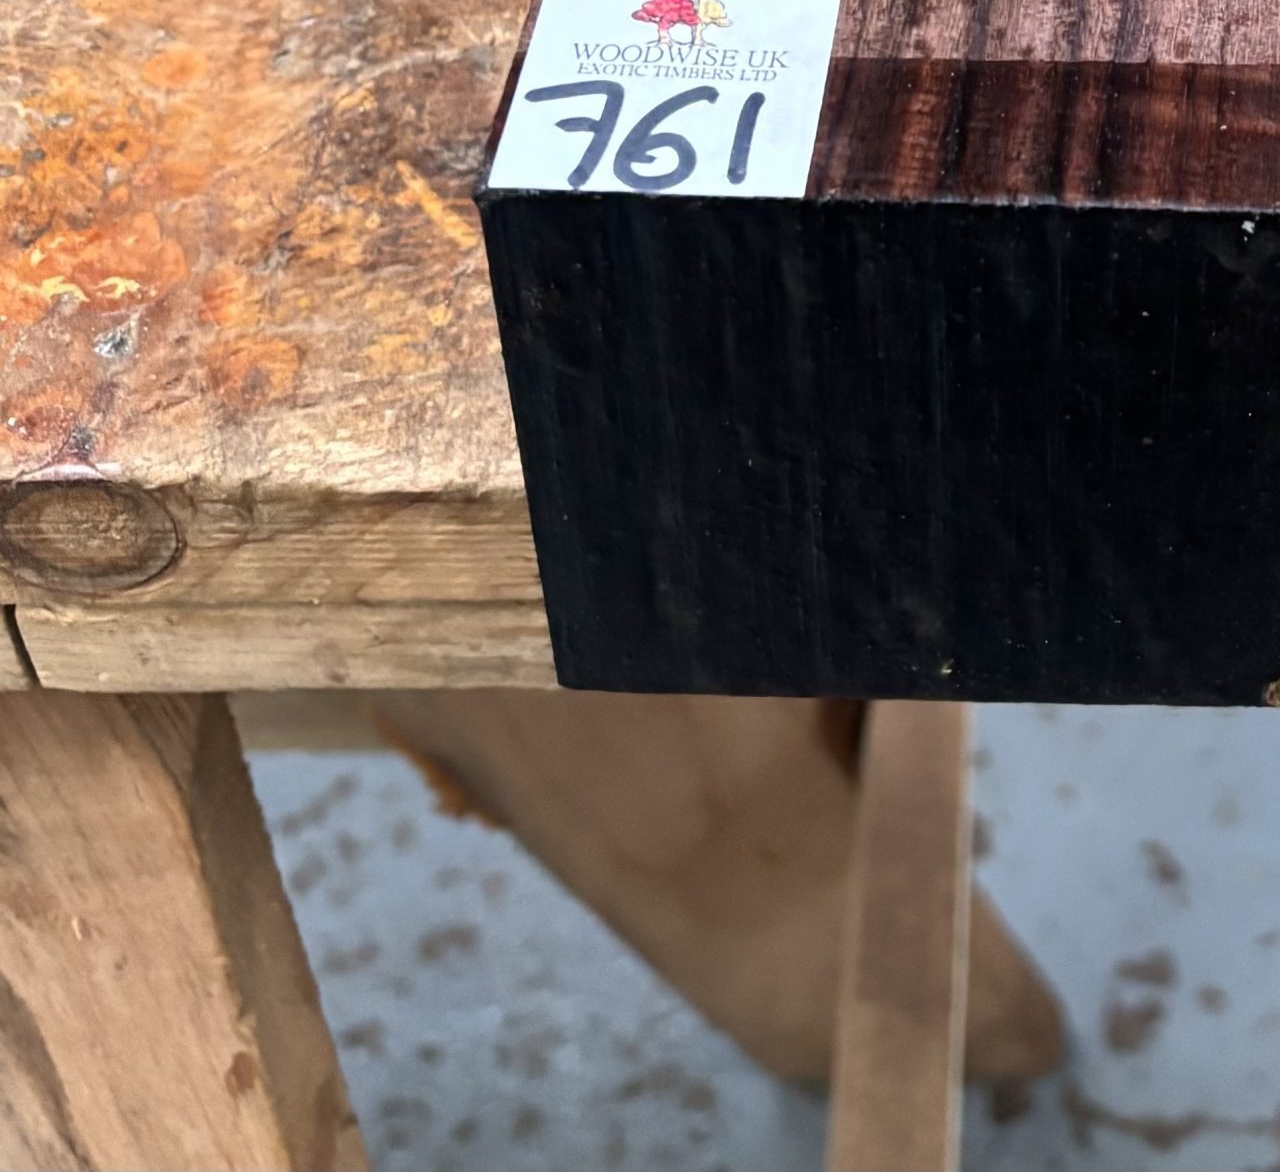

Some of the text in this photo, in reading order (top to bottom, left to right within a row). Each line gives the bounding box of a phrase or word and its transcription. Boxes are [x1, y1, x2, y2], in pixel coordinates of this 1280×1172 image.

[574, 43, 789, 68] WOODWISE UK
[577, 62, 778, 82] EXOTIC TIMBERS LTD
[524, 80, 766, 191] 761
